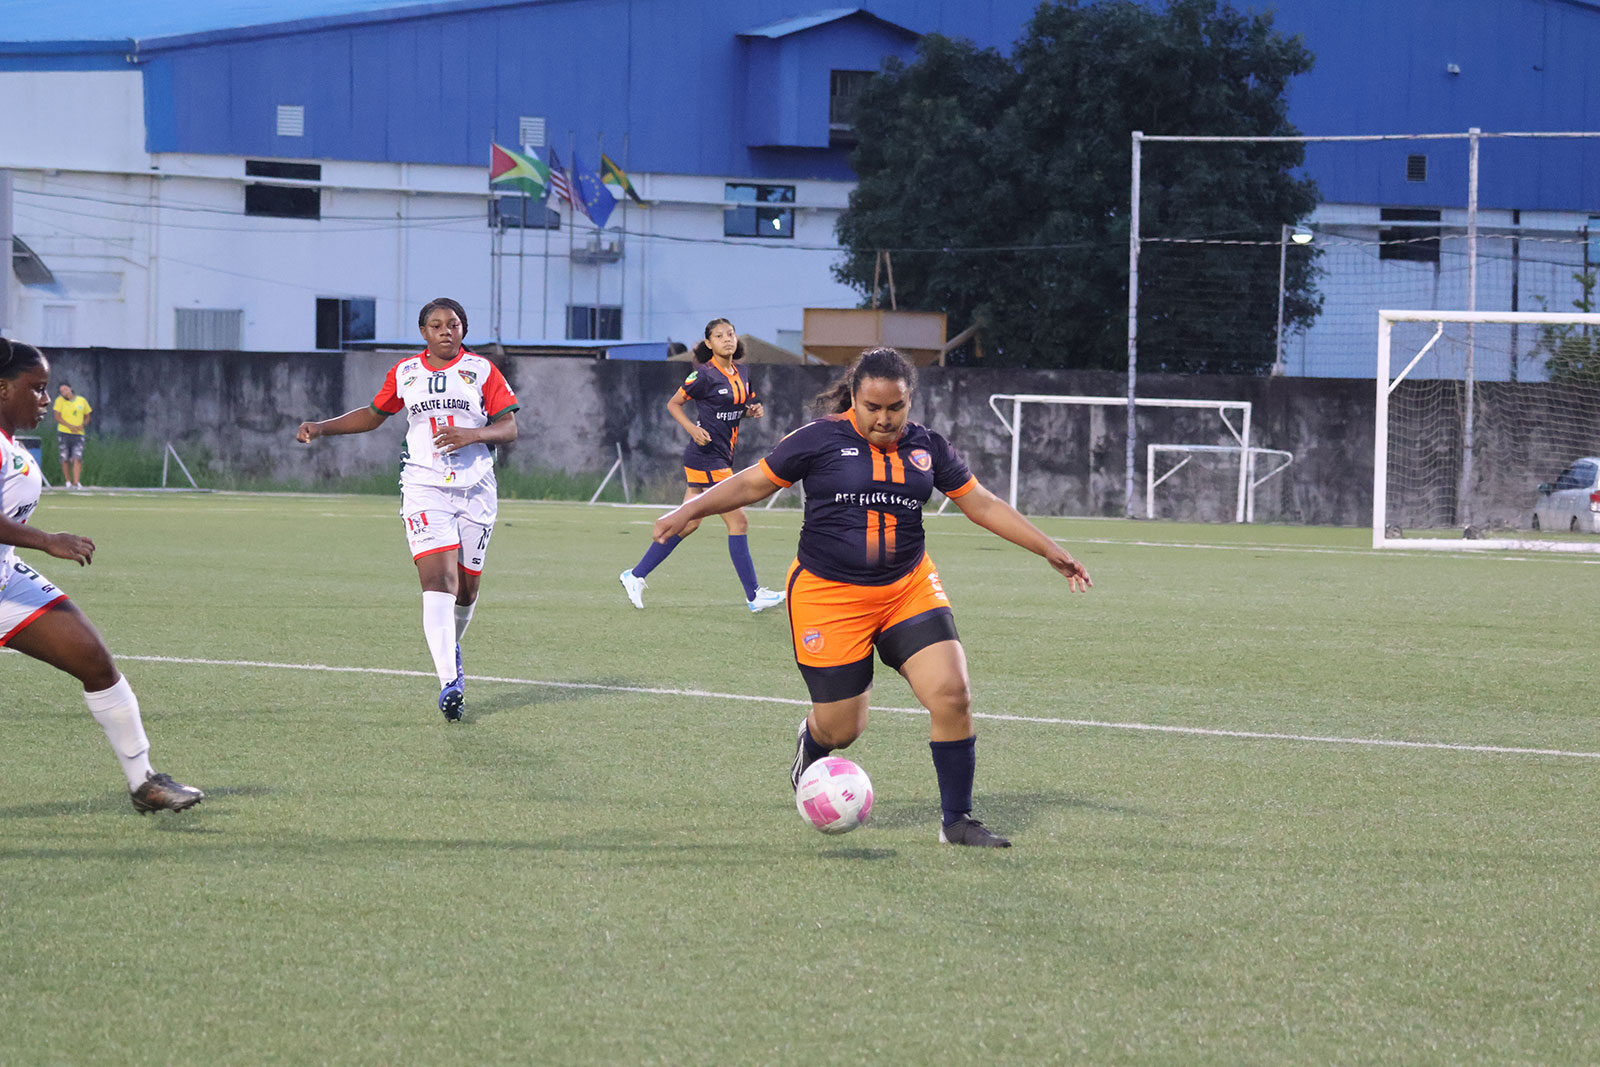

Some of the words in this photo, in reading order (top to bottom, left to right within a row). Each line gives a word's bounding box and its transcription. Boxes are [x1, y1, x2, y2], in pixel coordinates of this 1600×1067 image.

[427, 375, 447, 394] 10
[420, 399, 441, 412] ELITE
[443, 399, 470, 411] LEAGUE
